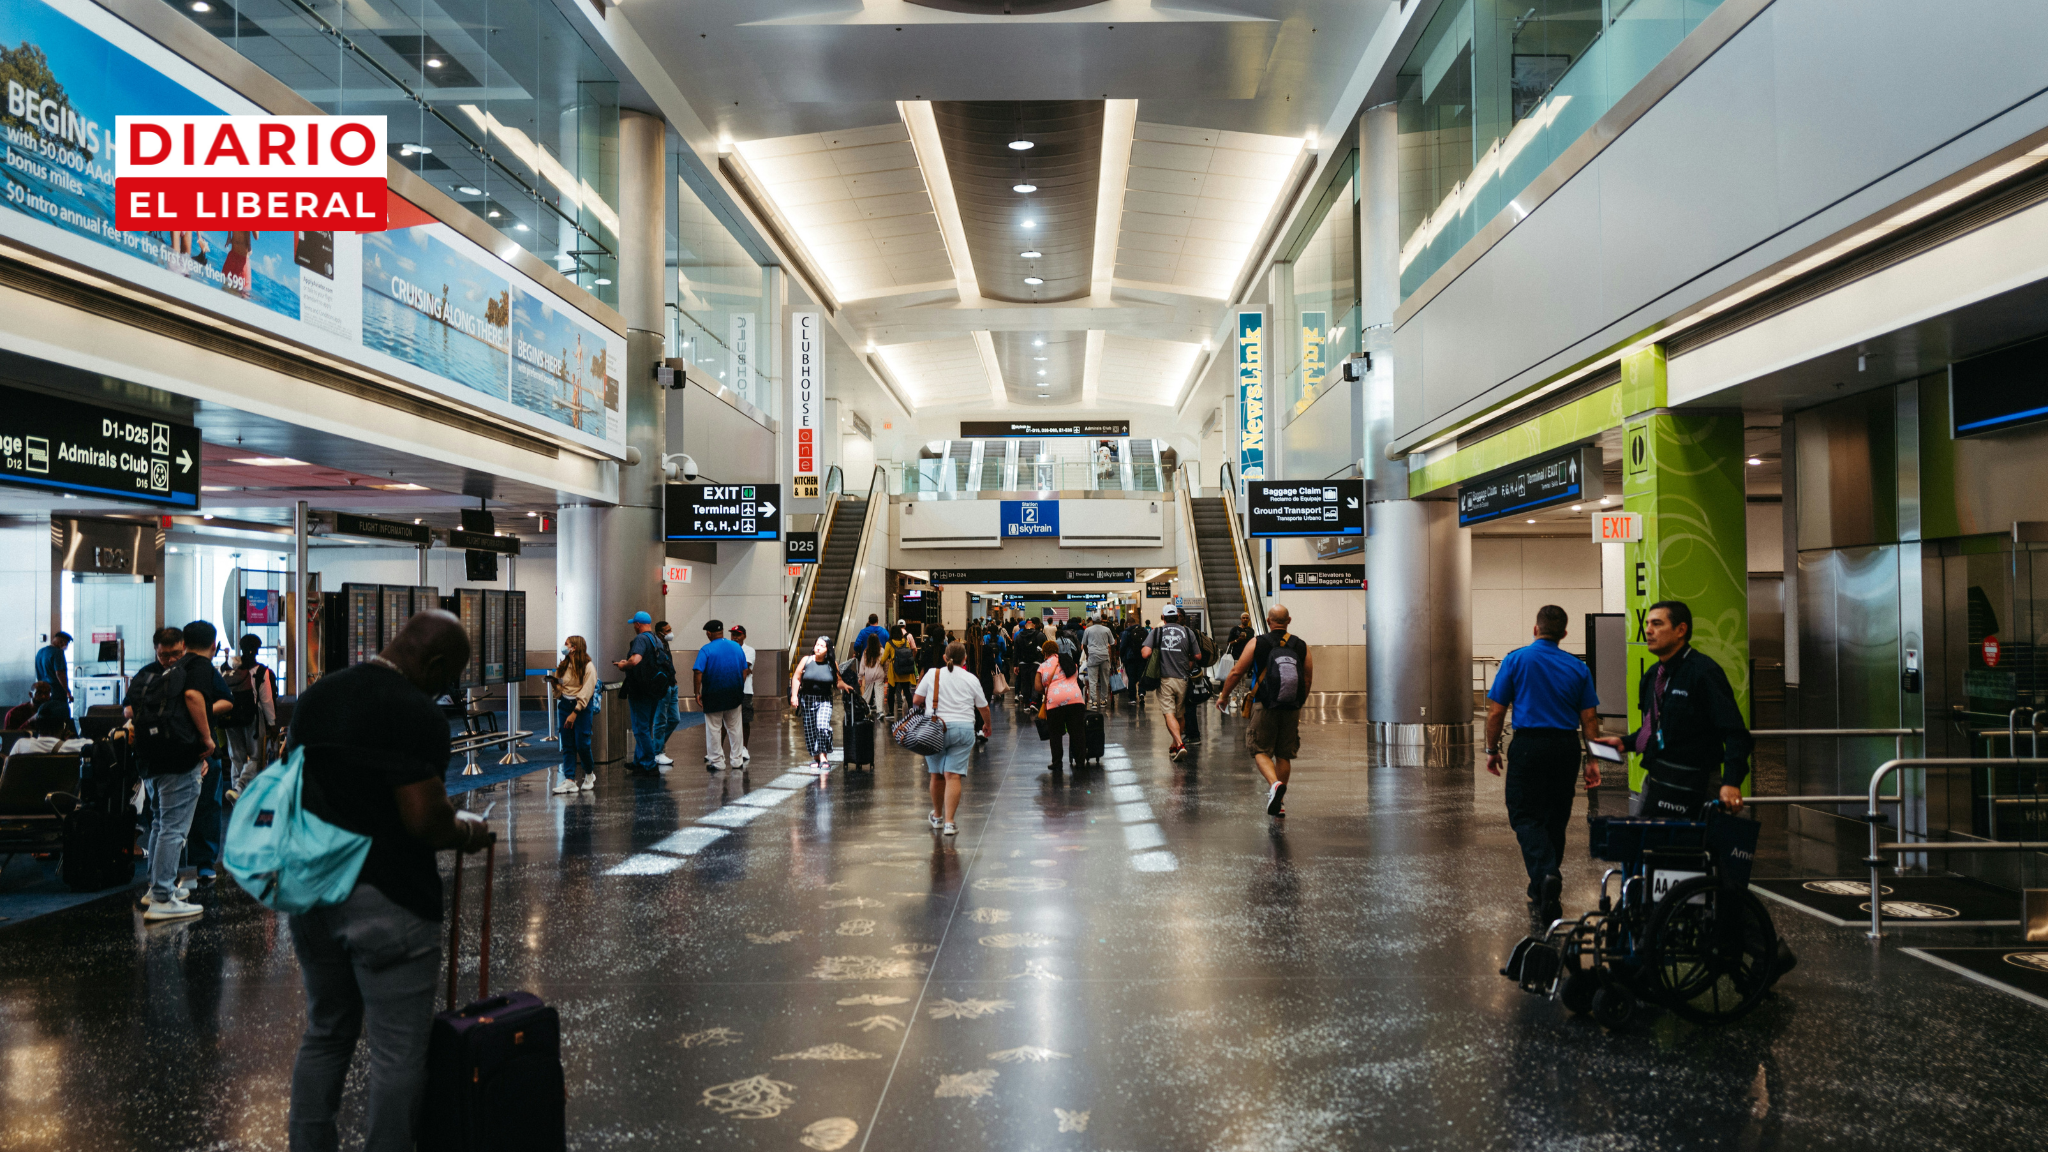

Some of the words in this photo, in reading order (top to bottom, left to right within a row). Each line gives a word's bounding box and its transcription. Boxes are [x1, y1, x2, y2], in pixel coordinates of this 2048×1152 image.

[9, 79, 99, 153] BEGINS
[7, 126, 37, 152] with
[40, 137, 83, 172] 50,000
[7, 146, 47, 180] bonus
[50, 170, 85, 197] miles.
[7, 181, 24, 203] $0
[27, 188, 58, 216] intro
[60, 207, 100, 234] annual
[102, 220, 121, 242] fee
[123, 231, 139, 248] for
[141, 237, 159, 257] the
[160, 245, 181, 266] first
[182, 254, 204, 277] year,
[205, 264, 226, 285] then
[391, 275, 442, 319] CRUISING
[443, 302, 475, 335] ALONG
[477, 318, 503, 347] THERE
[518, 339, 544, 368] BEGINS
[545, 352, 562, 376] HERE
[800, 316, 811, 427] CLUBHOUSE
[1240, 326, 1264, 451] NewsLink
[102, 418, 149, 445] D1-D25
[58, 442, 117, 468] Admirals
[120, 455, 149, 474] Club
[801, 432, 810, 471] one
[7, 457, 22, 470] D12
[794, 476, 818, 485] KITCHEN
[1527, 467, 1544, 485] Terminal
[1547, 463, 1558, 479] EXIT
[703, 487, 739, 500] EXIT
[794, 487, 799, 496] &
[804, 487, 818, 497] BAR
[1263, 488, 1297, 496] Baggage
[1299, 487, 1321, 495] Claim
[693, 504, 739, 515] Terminal
[1026, 508, 1035, 522] 2
[1254, 507, 1283, 515] Ground
[1283, 506, 1321, 516] Transport
[359, 521, 379, 533] FLIGHT
[379, 523, 413, 537] INFORMATION
[694, 521, 703, 532] F,
[705, 521, 717, 532] G,
[720, 521, 730, 532] H,
[733, 521, 739, 531] J
[1019, 523, 1052, 535] skytrain
[1602, 517, 1631, 539] EXIT
[789, 541, 814, 552] D25
[669, 567, 687, 581] EXIT
[788, 566, 801, 576] EXIT
[1658, 799, 1689, 814] envoy
[1654, 877, 1668, 894] AA
